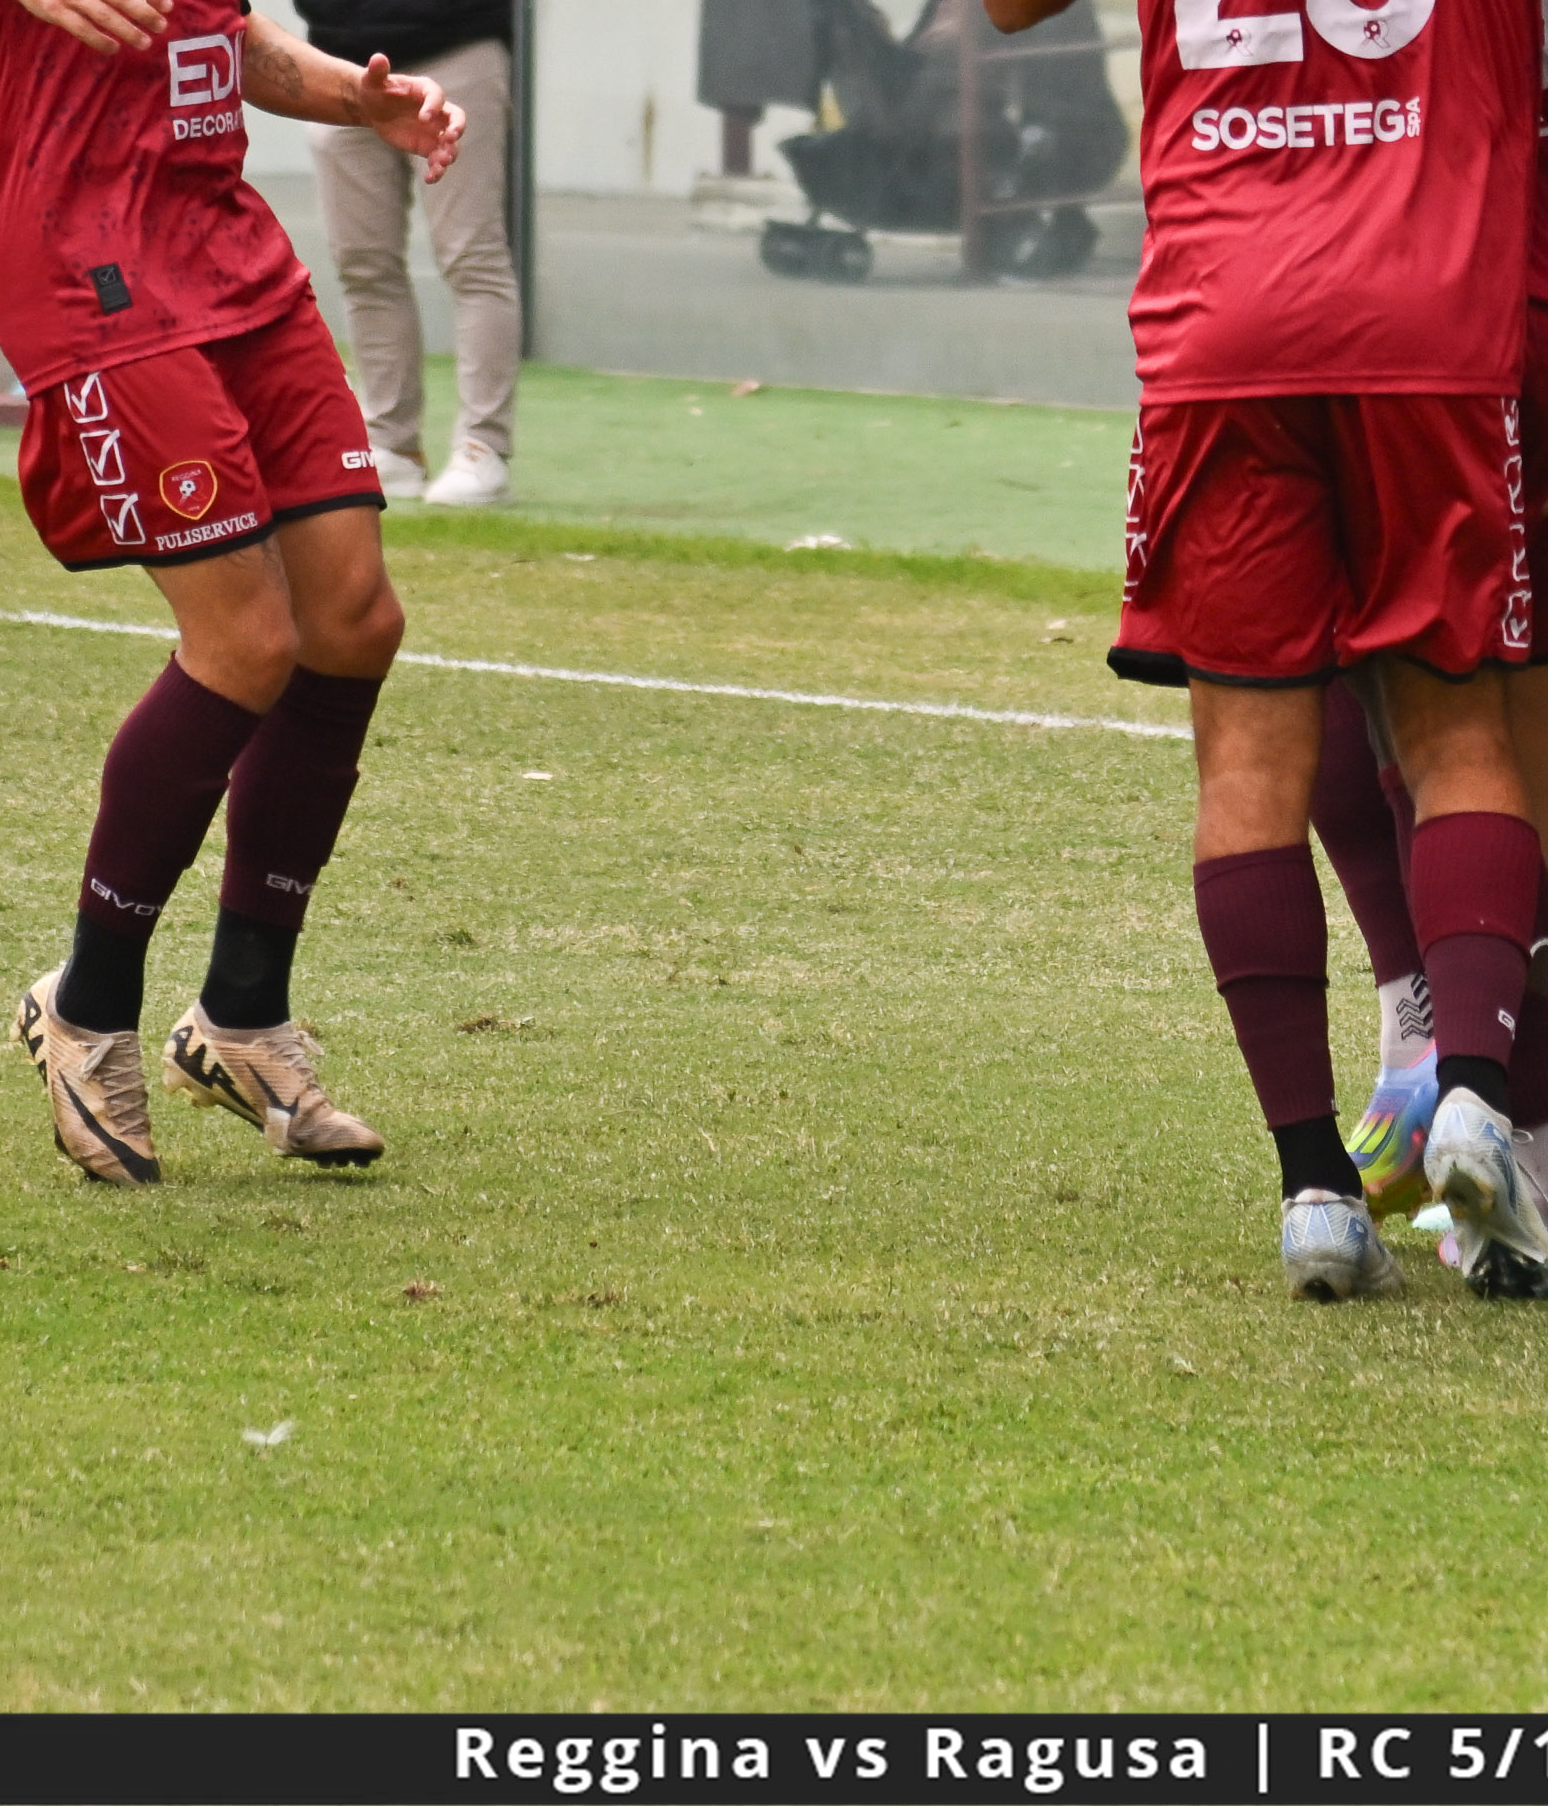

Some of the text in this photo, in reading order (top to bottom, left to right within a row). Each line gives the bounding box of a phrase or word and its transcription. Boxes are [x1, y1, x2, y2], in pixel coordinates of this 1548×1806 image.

[1191, 96, 1421, 151] SOSETEG SPA
[155, 512, 258, 551] PULISERVICE
[90, 877, 162, 916] GIVO
[265, 873, 316, 895] GIV
